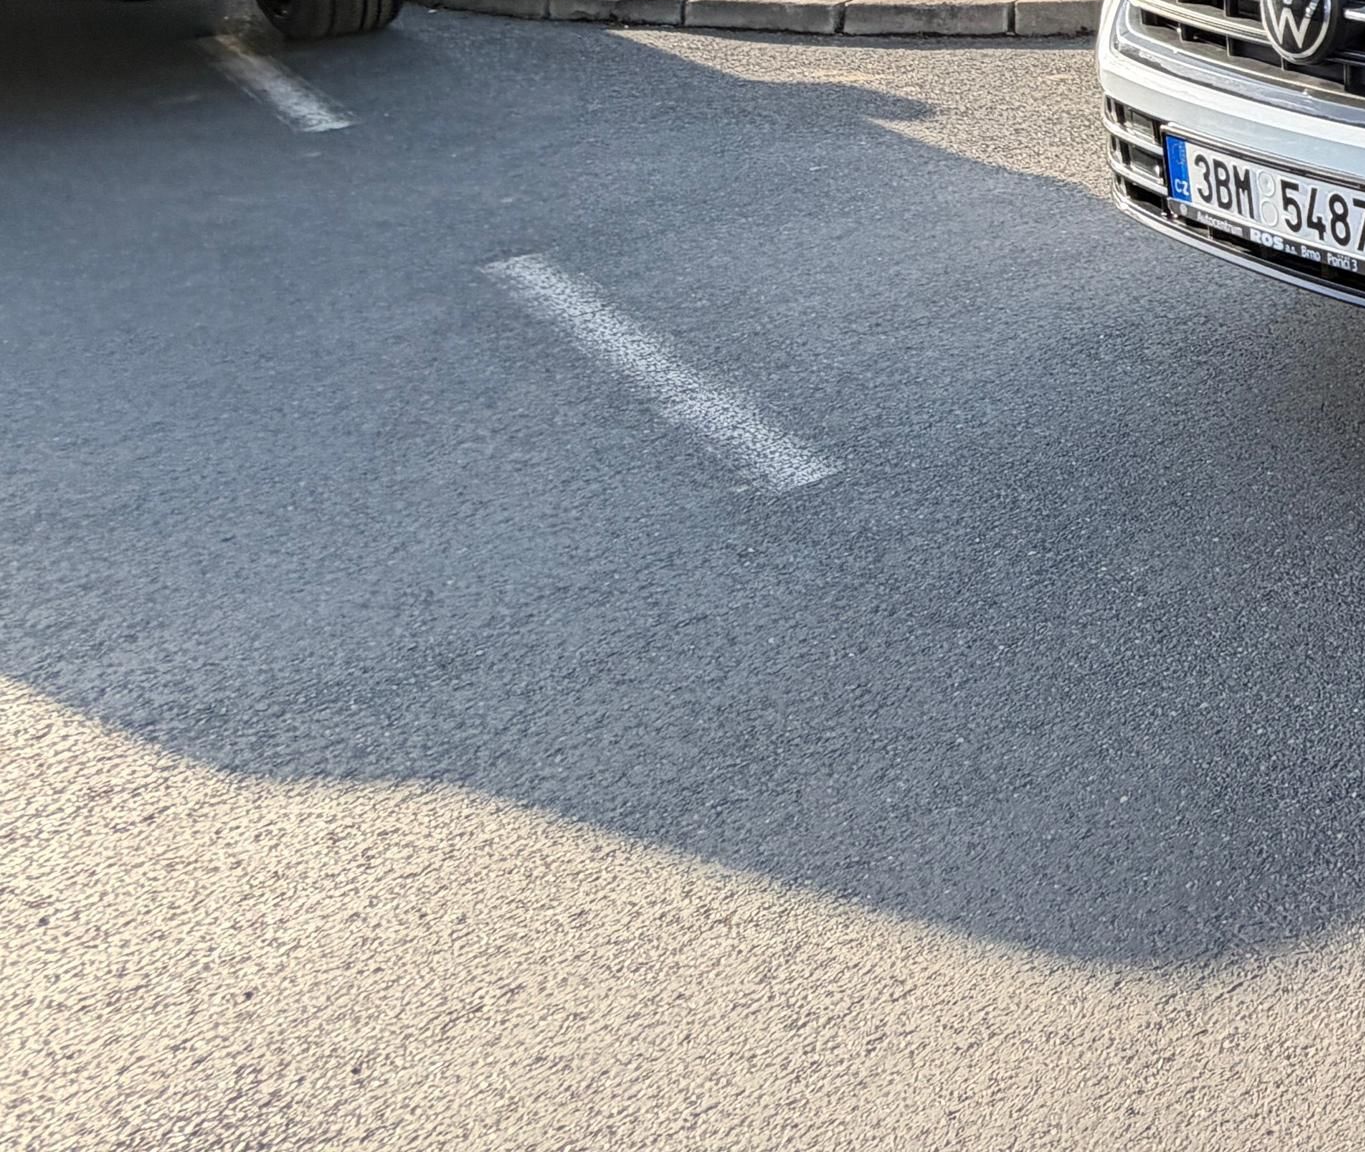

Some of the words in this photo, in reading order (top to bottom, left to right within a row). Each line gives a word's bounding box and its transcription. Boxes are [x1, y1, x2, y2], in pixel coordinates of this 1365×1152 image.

[1174, 178, 1190, 196] CZ
[1194, 154, 1255, 220] 3BM
[1249, 228, 1284, 250] ROS
[1301, 245, 1322, 262] Brno
[1351, 259, 1358, 272] 3
